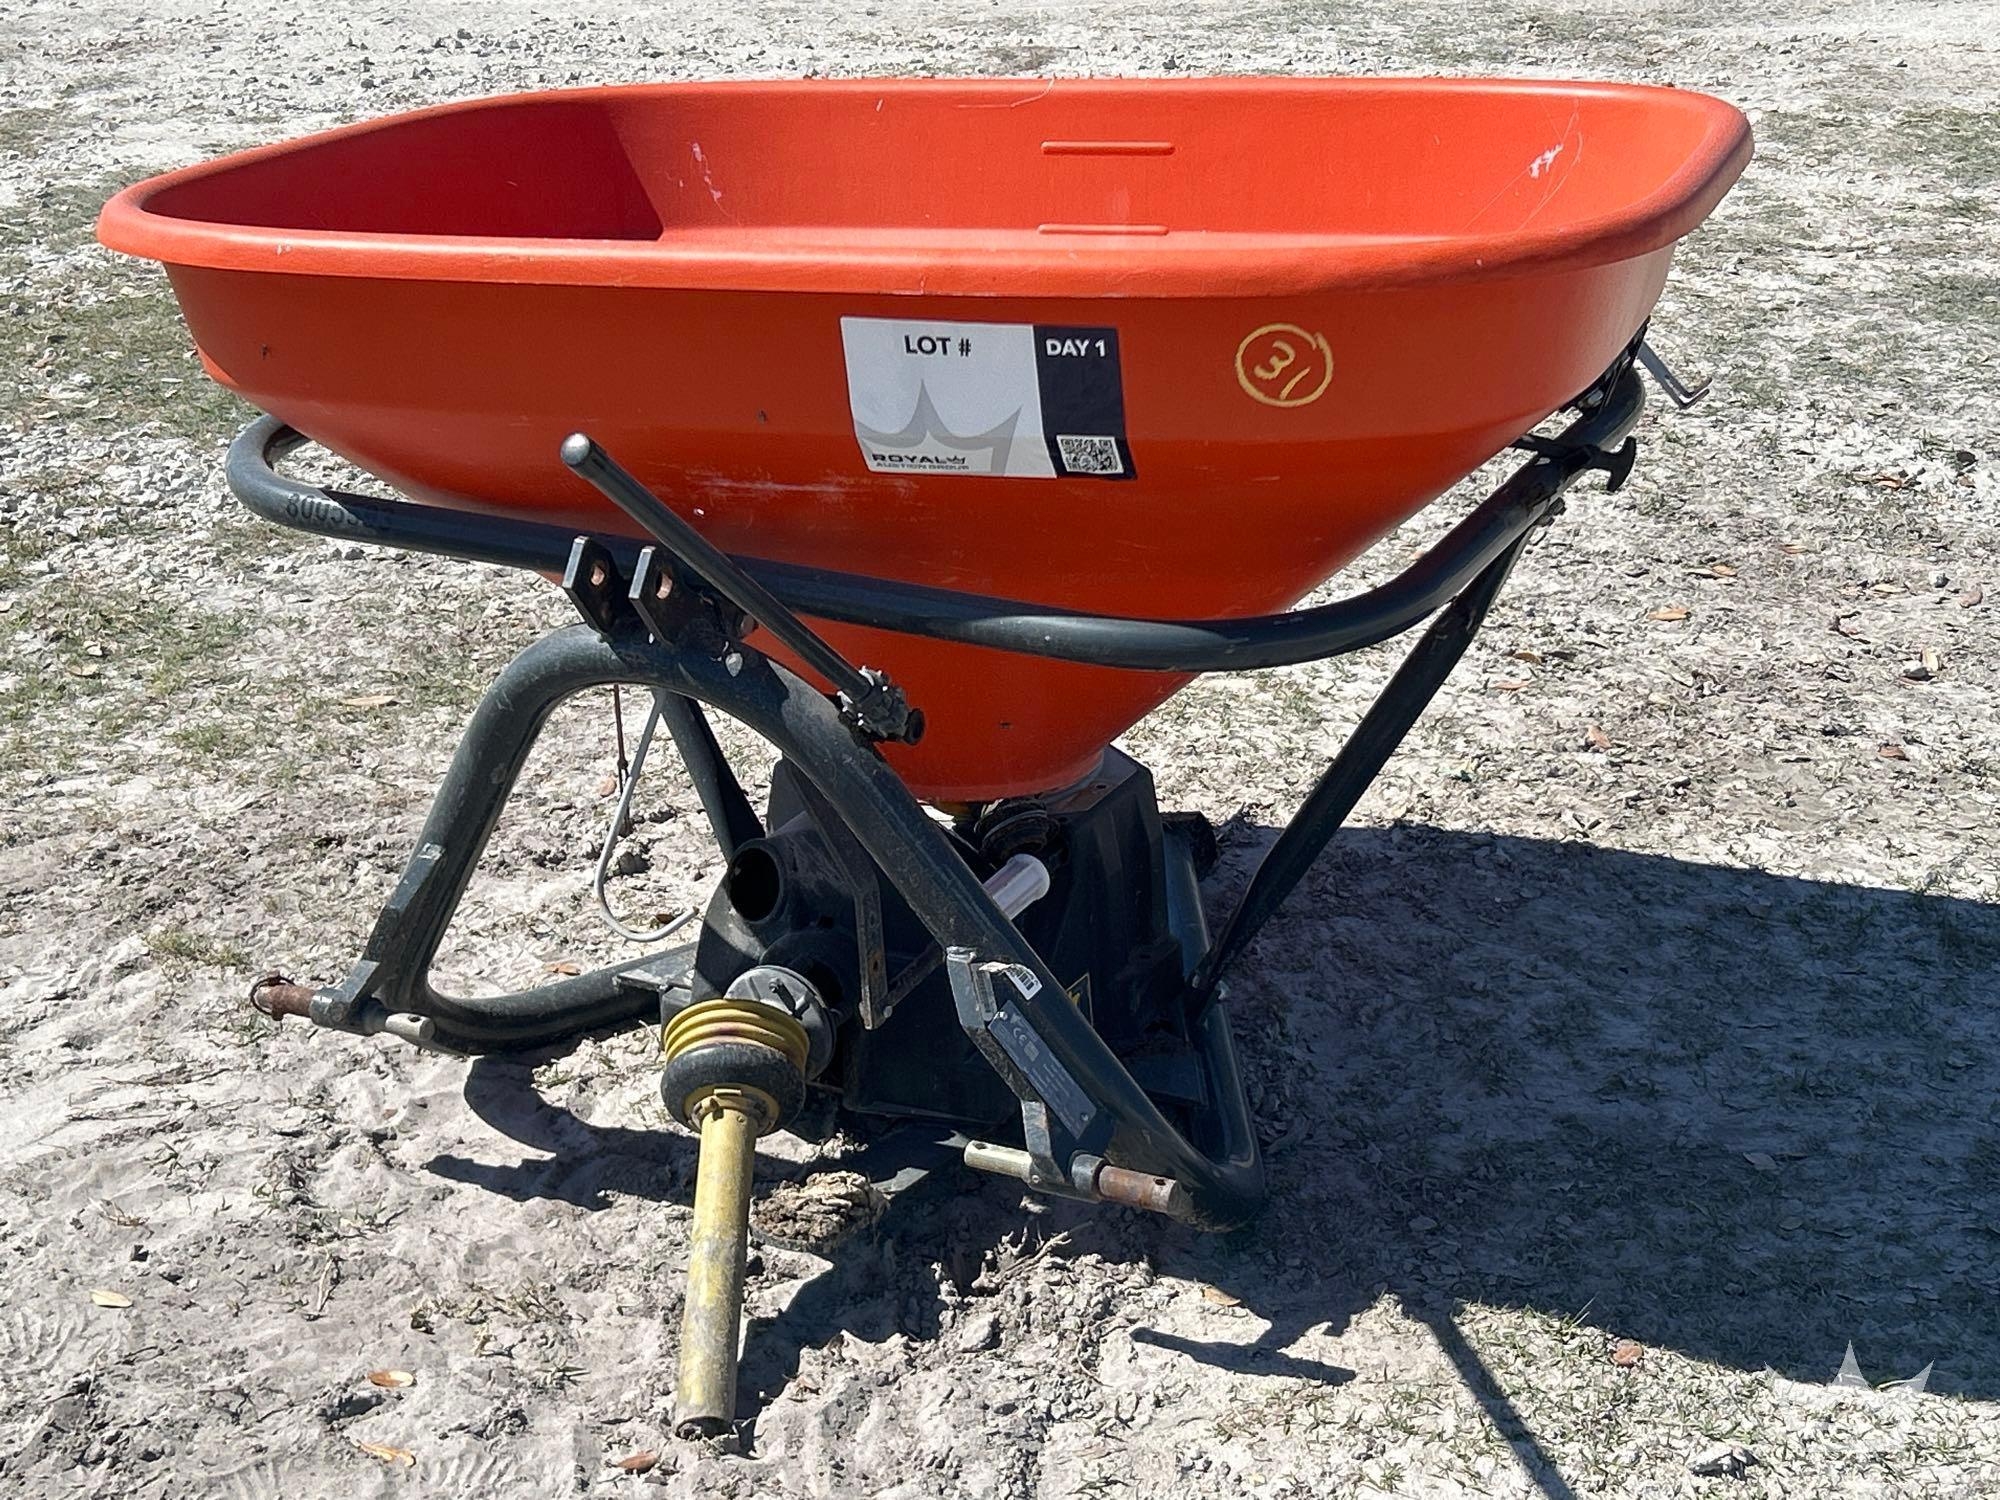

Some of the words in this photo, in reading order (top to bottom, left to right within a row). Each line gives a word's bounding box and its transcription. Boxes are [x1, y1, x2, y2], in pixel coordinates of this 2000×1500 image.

[904, 335, 951, 355] LOT
[958, 338, 971, 357] #
[1045, 338, 1089, 357] DAY
[1095, 339, 1106, 357] 1
[872, 453, 947, 464] ROYAL
